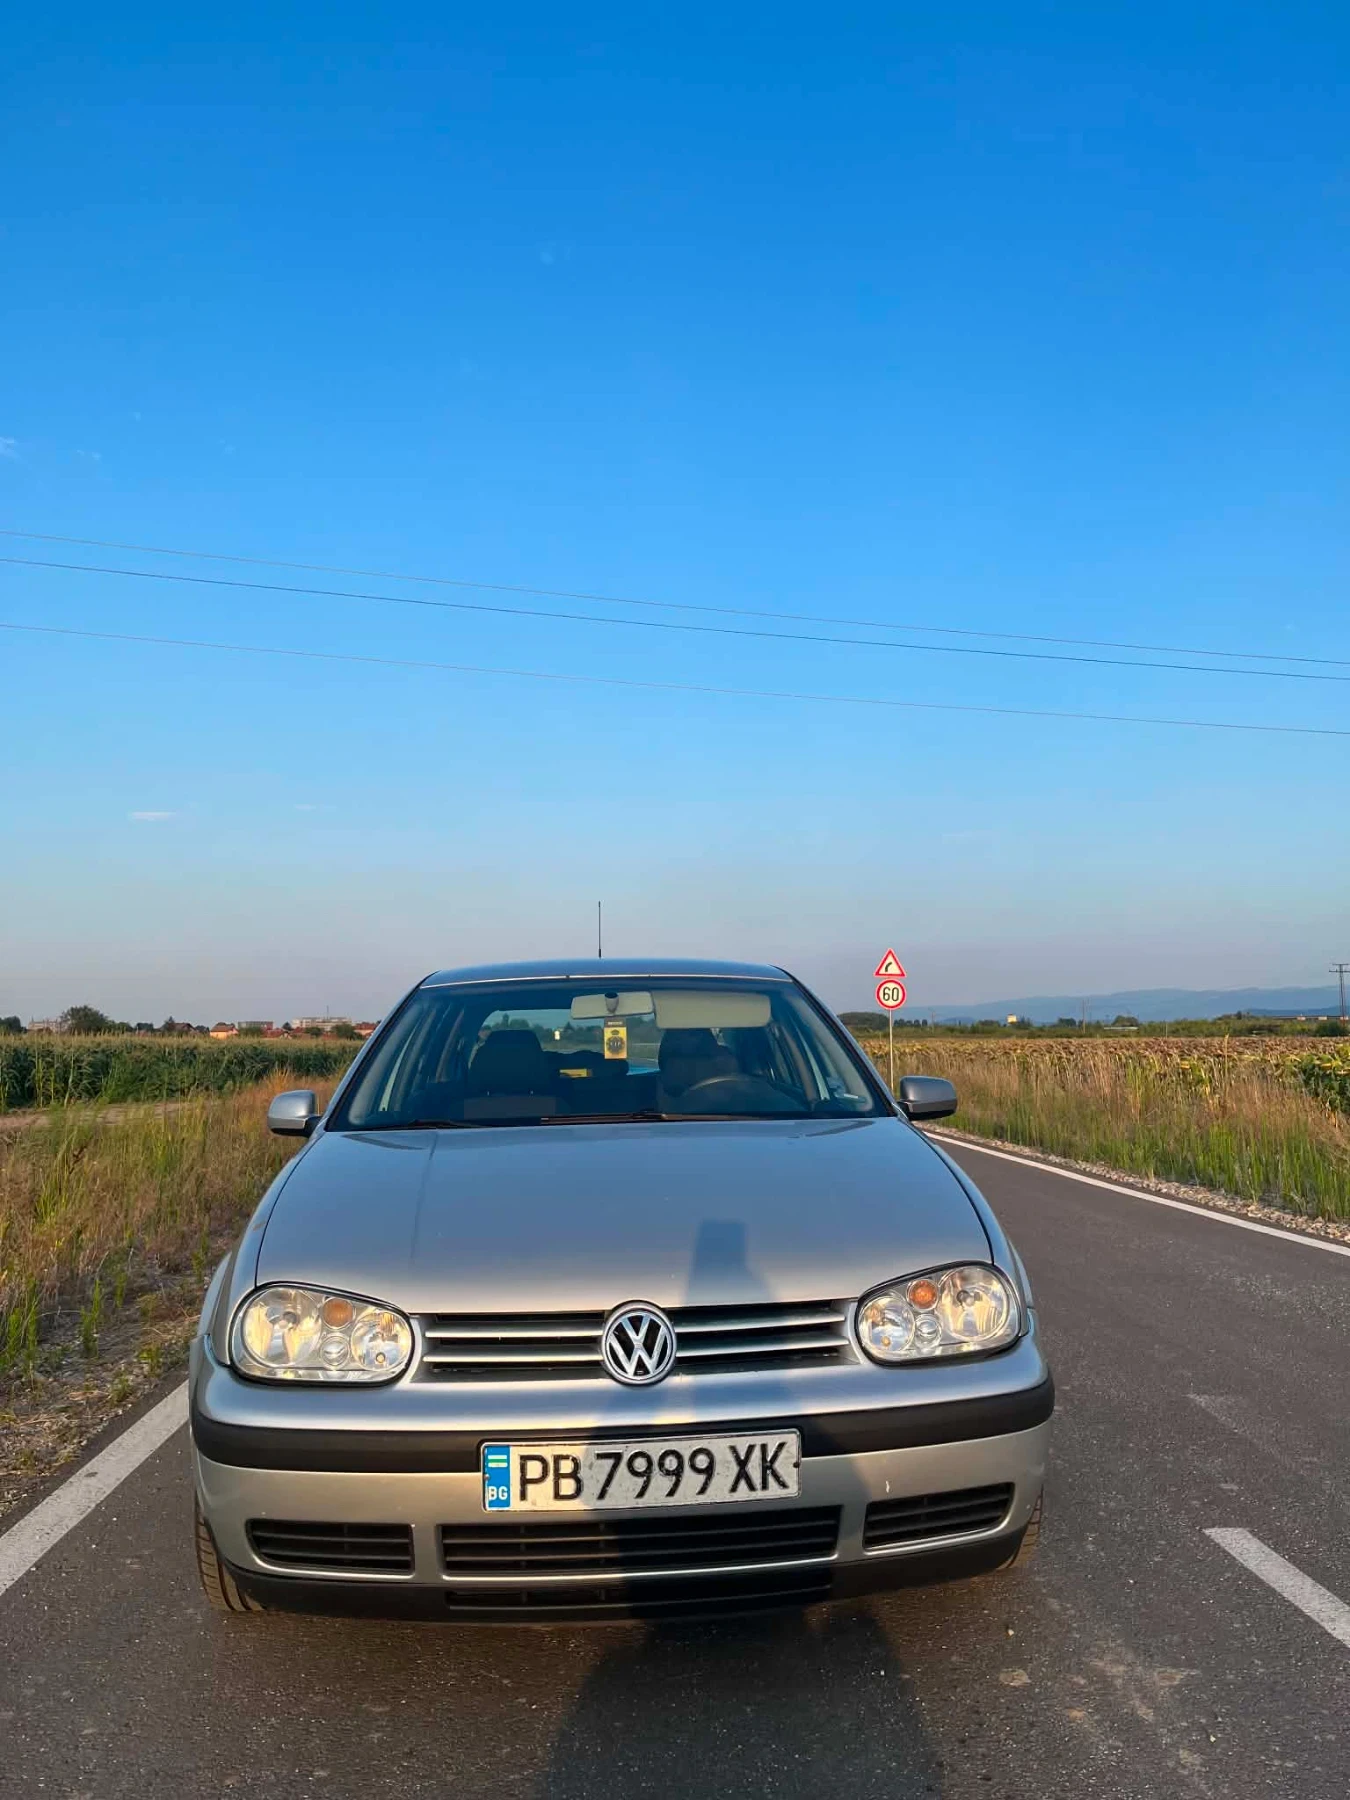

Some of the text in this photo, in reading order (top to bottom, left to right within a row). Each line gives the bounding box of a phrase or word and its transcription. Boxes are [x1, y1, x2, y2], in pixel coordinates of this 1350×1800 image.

[882, 986, 900, 1002] 60
[606, 1312, 669, 1377] VW
[519, 1441, 790, 1502] PB 7999 XK
[487, 1485, 509, 1501] BG
